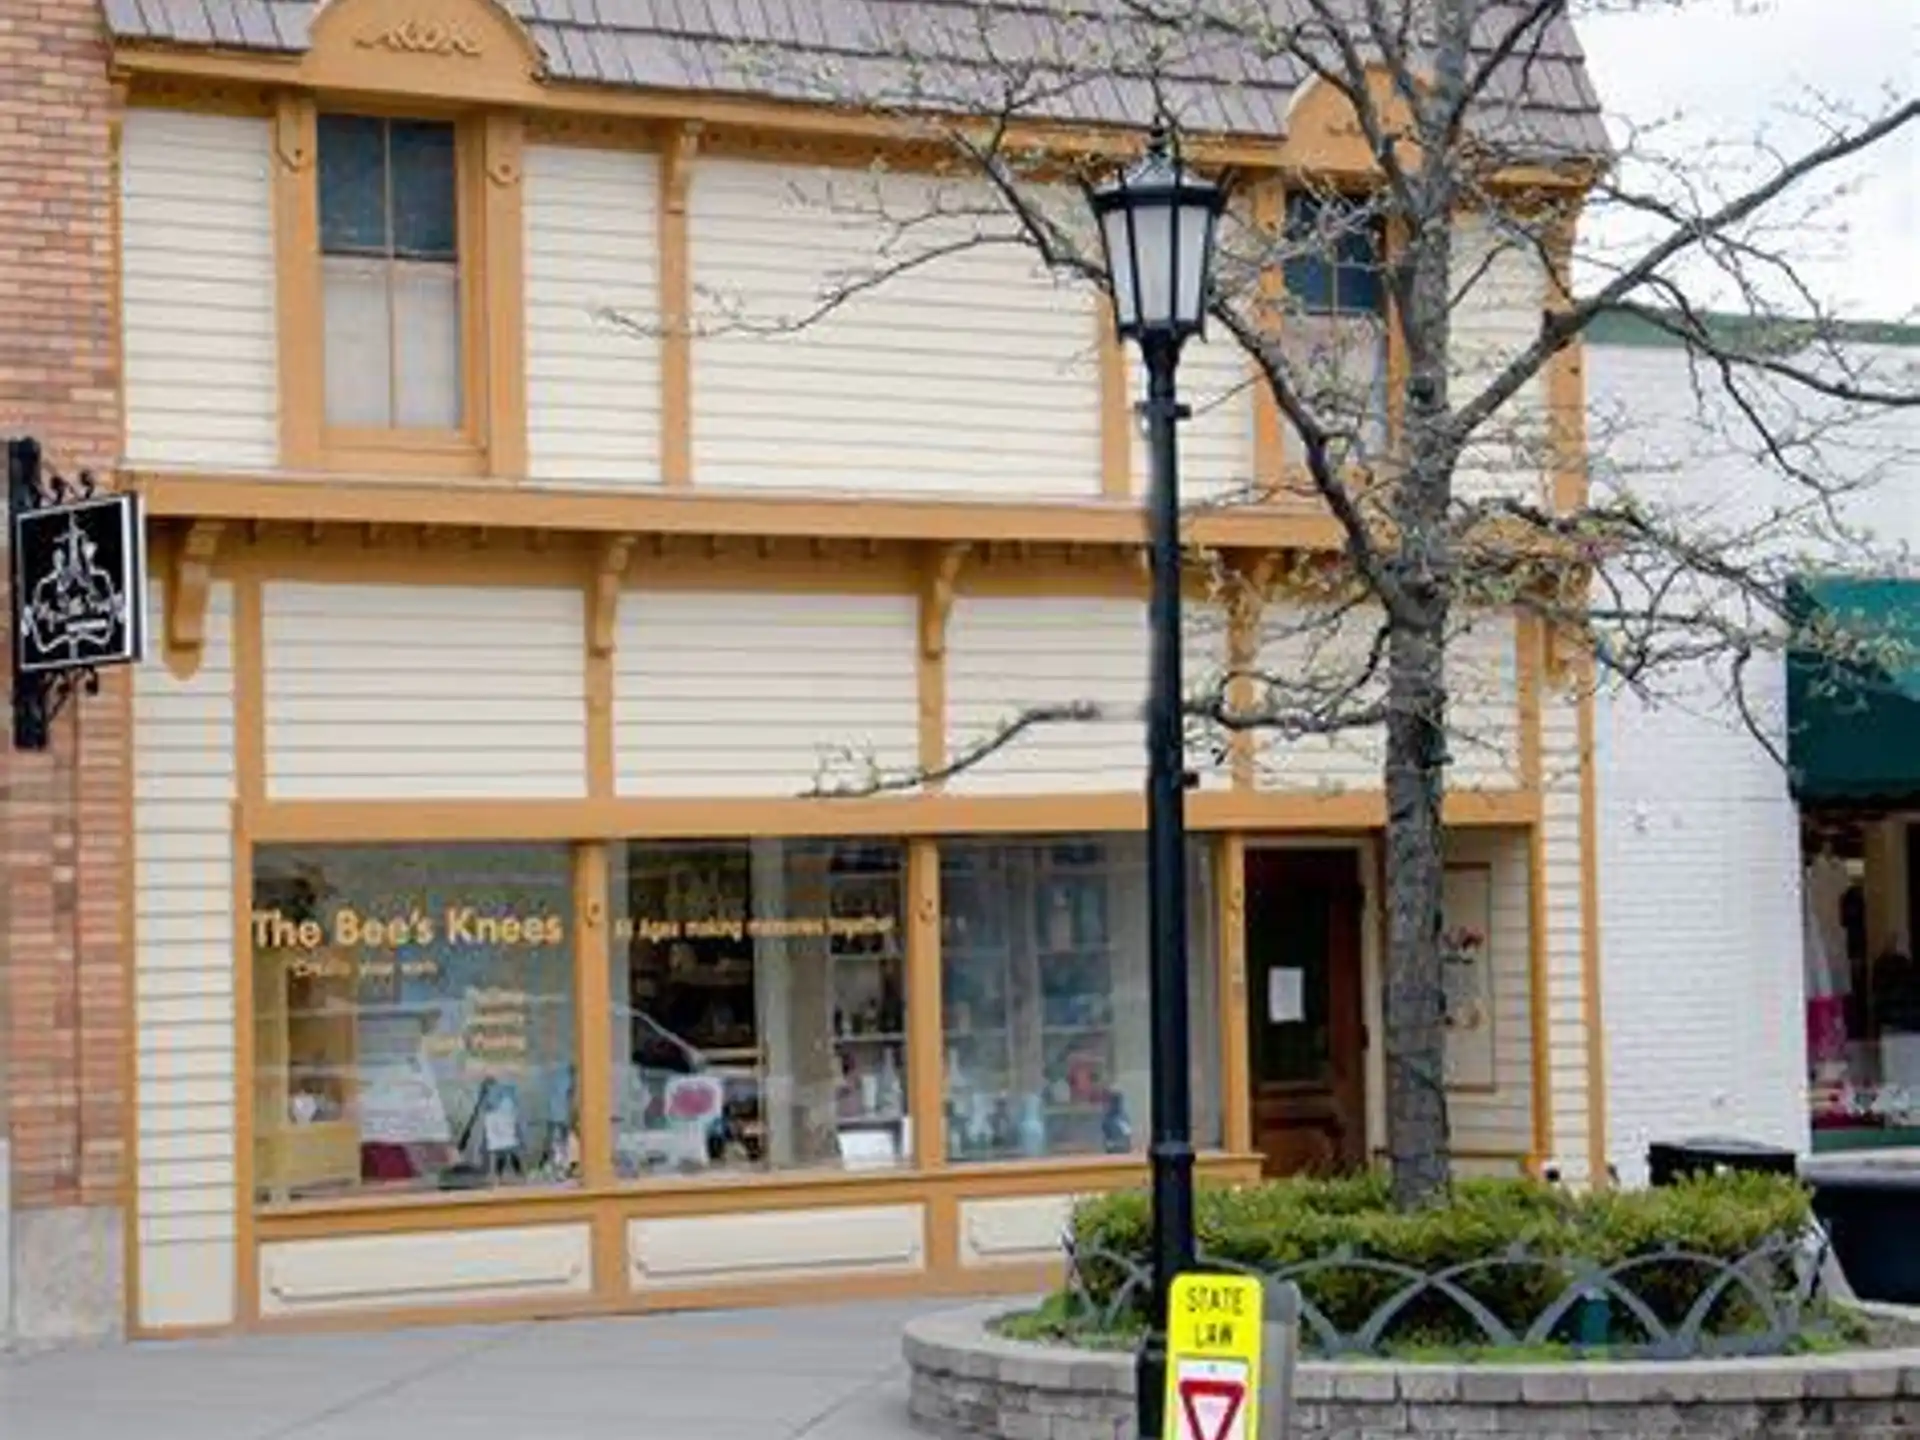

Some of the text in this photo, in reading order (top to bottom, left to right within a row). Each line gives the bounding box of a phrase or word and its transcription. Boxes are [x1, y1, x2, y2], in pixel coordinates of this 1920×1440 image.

[251, 906, 564, 948] The Bee's Knees
[1186, 1286, 1245, 1317] STATE
[1194, 1322, 1234, 1349] LAW
